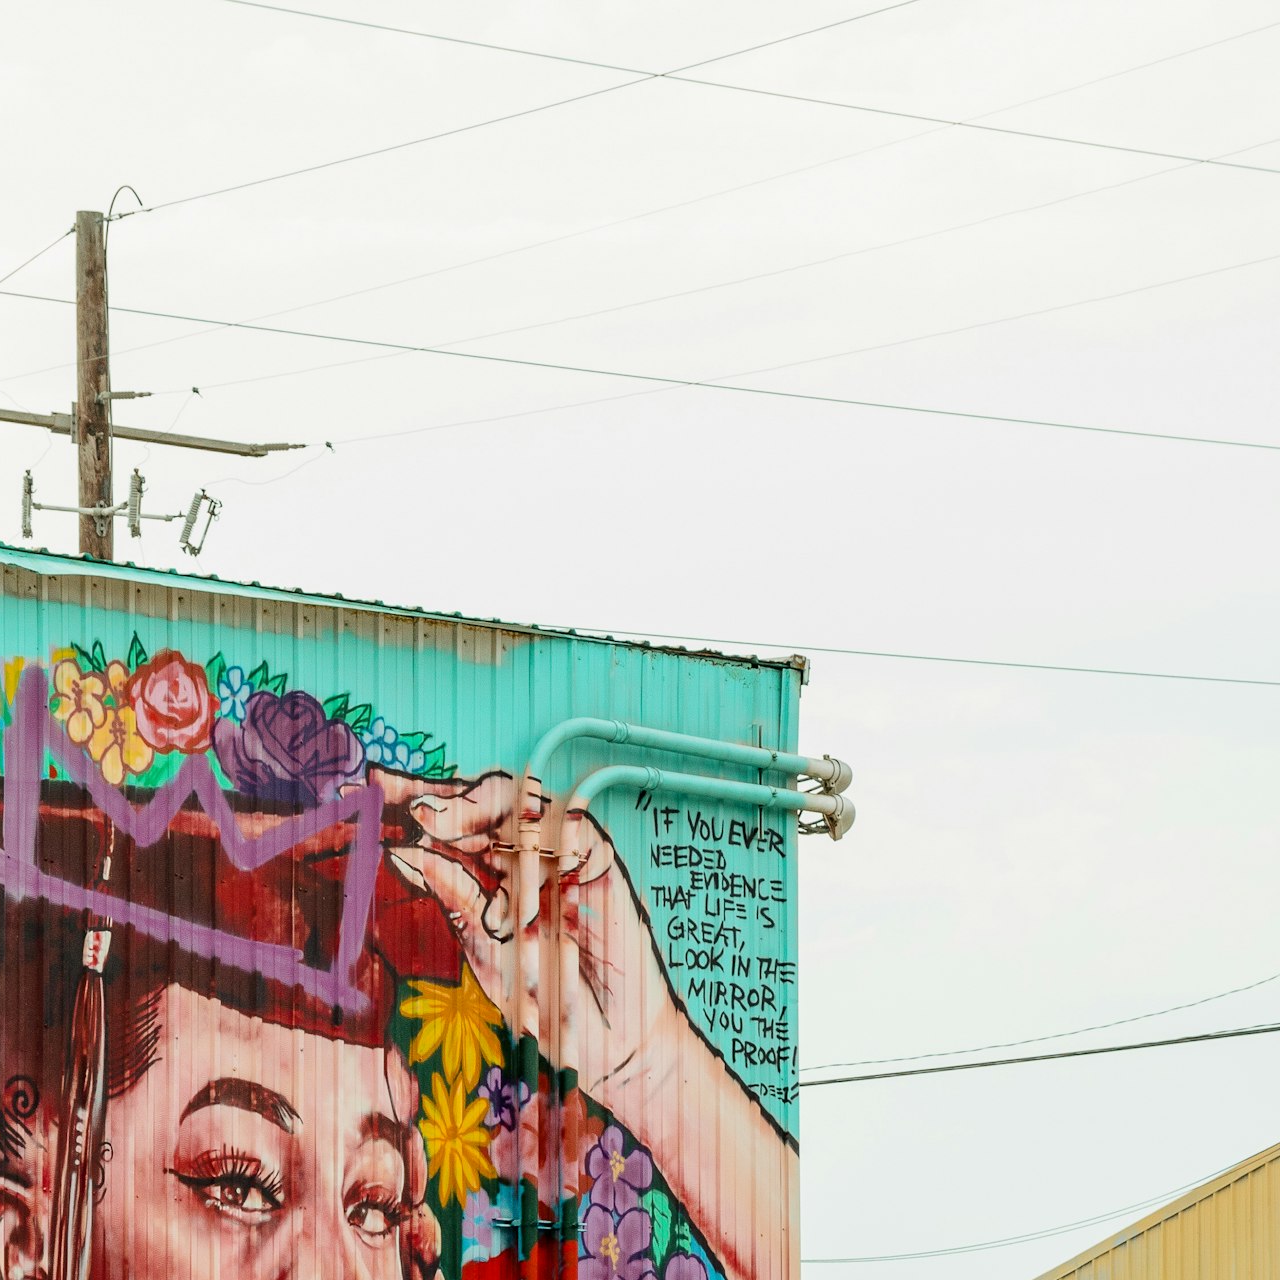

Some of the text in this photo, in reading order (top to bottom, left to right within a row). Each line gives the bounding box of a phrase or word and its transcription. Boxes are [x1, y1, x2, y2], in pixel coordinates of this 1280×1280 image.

[687, 809, 725, 842] YOU
[728, 819, 787, 858] EVER
[650, 842, 726, 870] NEEDED
[690, 870, 787, 902] EVIDENCE
[651, 885, 776, 929] THAT LIFE IS
[667, 915, 746, 953] GREAT,
[668, 943, 797, 985] LOOK IN THE
[702, 1008, 789, 1042] YOU THE
[731, 1037, 798, 1075] PROOF!
